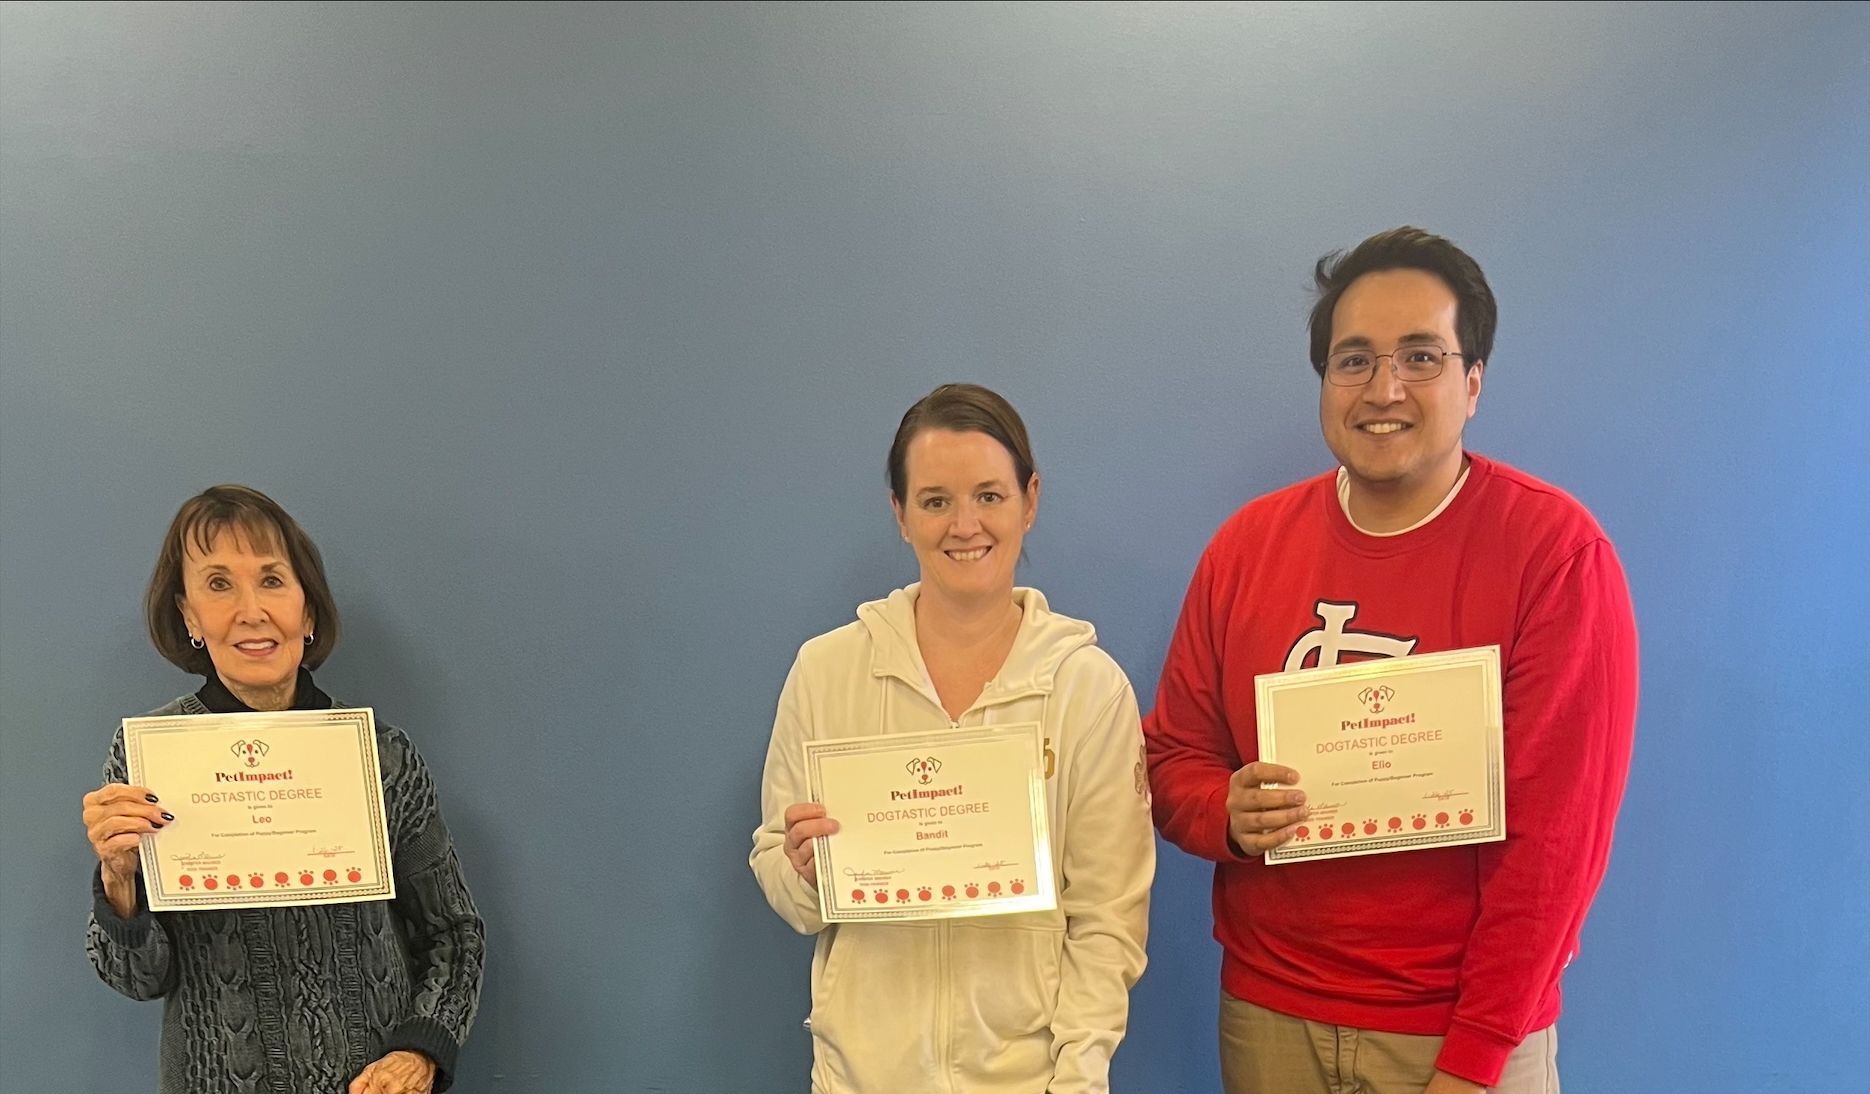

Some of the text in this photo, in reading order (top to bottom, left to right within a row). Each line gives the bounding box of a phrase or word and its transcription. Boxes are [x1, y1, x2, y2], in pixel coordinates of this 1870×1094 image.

[1341, 713, 1416, 731] PetImpact!
[1316, 730, 1443, 754] DOGTASTIC DEGREE
[1372, 760, 1392, 770] Elio
[215, 769, 293, 783] PetImpact!
[191, 788, 323, 804] DOGTASTIC DEGREE
[890, 785, 963, 800] PetImpact!
[252, 815, 272, 824] Leo
[867, 802, 990, 823] DOGTASTIC DEGREE
[916, 830, 948, 840] Bandit
